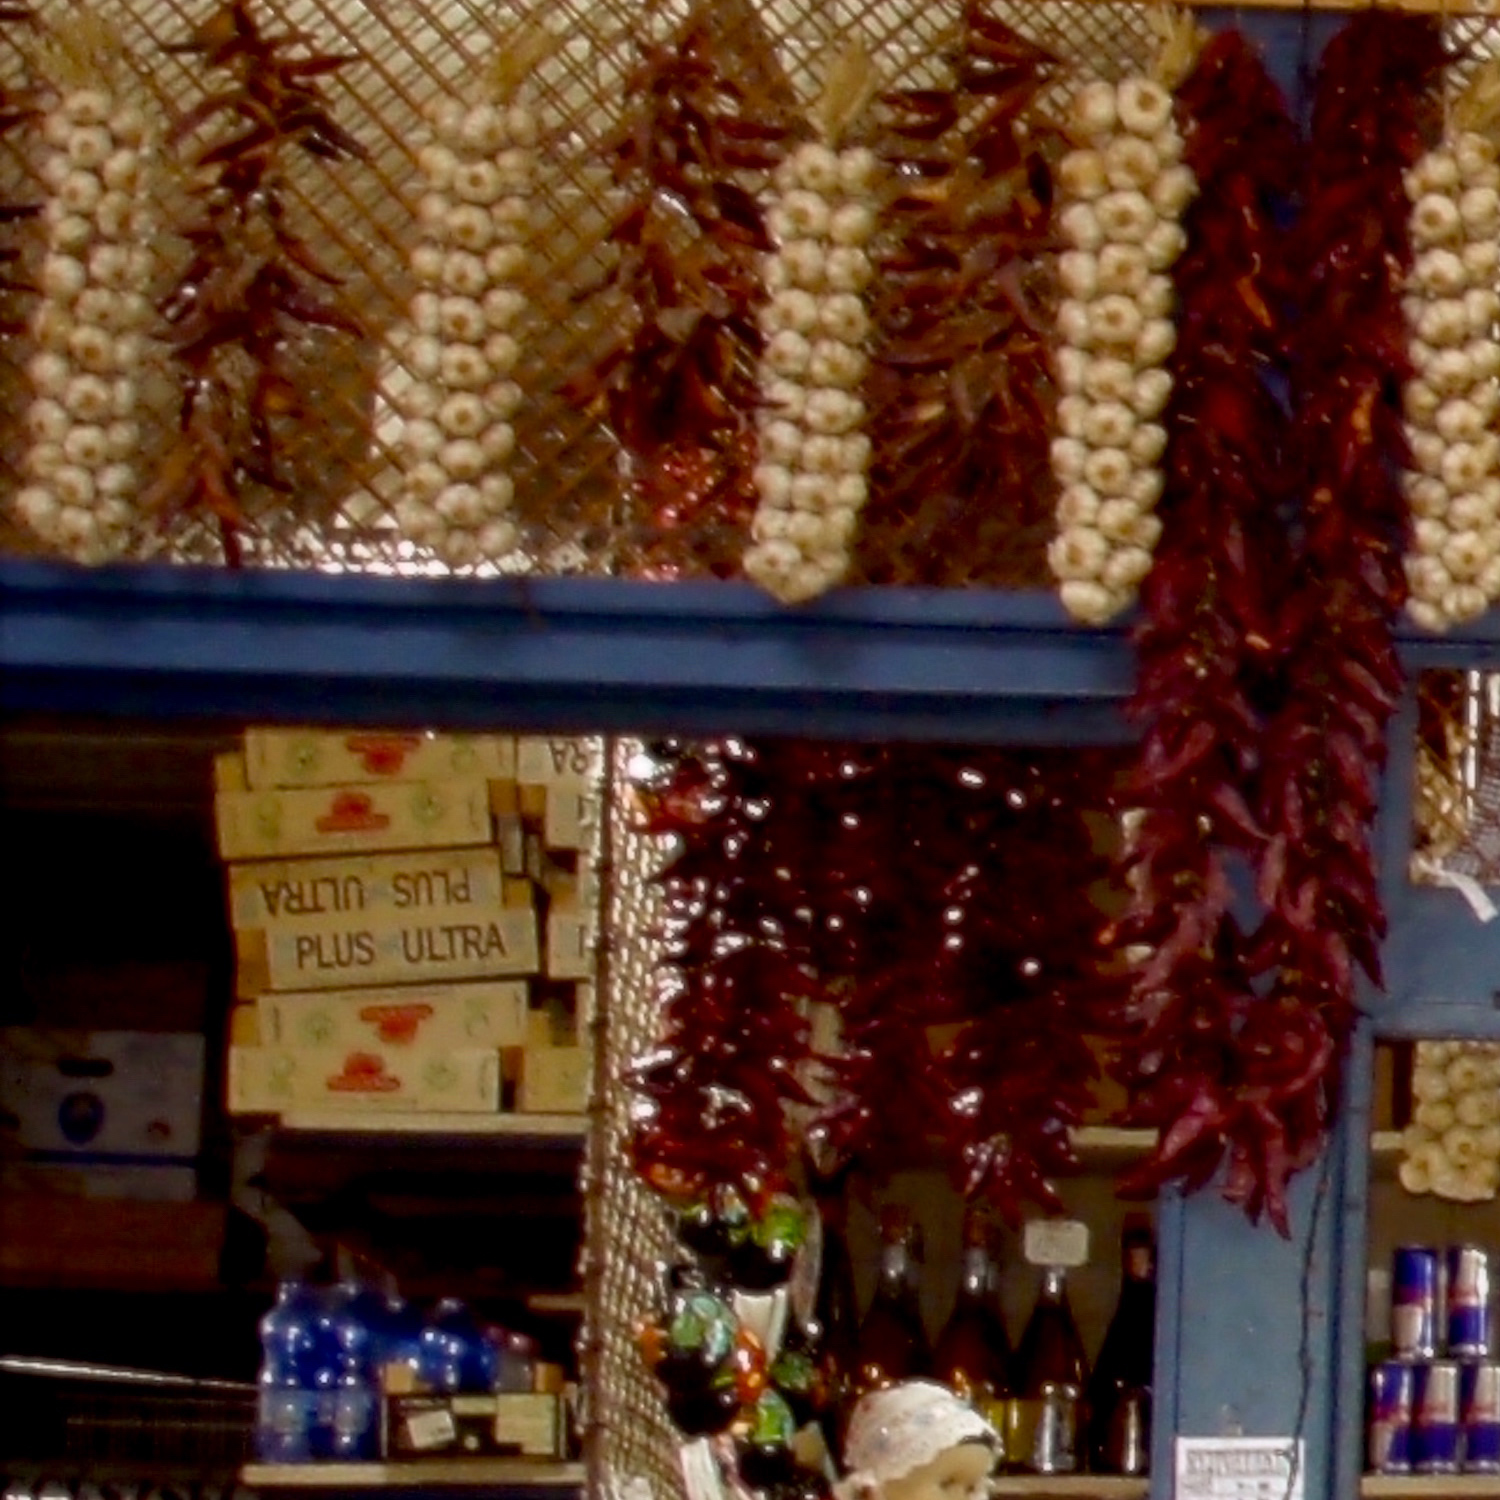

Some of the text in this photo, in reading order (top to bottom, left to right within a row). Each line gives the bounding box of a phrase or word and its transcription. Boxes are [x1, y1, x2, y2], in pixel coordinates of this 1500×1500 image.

[259, 873, 471, 917] PLUS ULTRA
[296, 921, 507, 970] PLUS ULTRA
